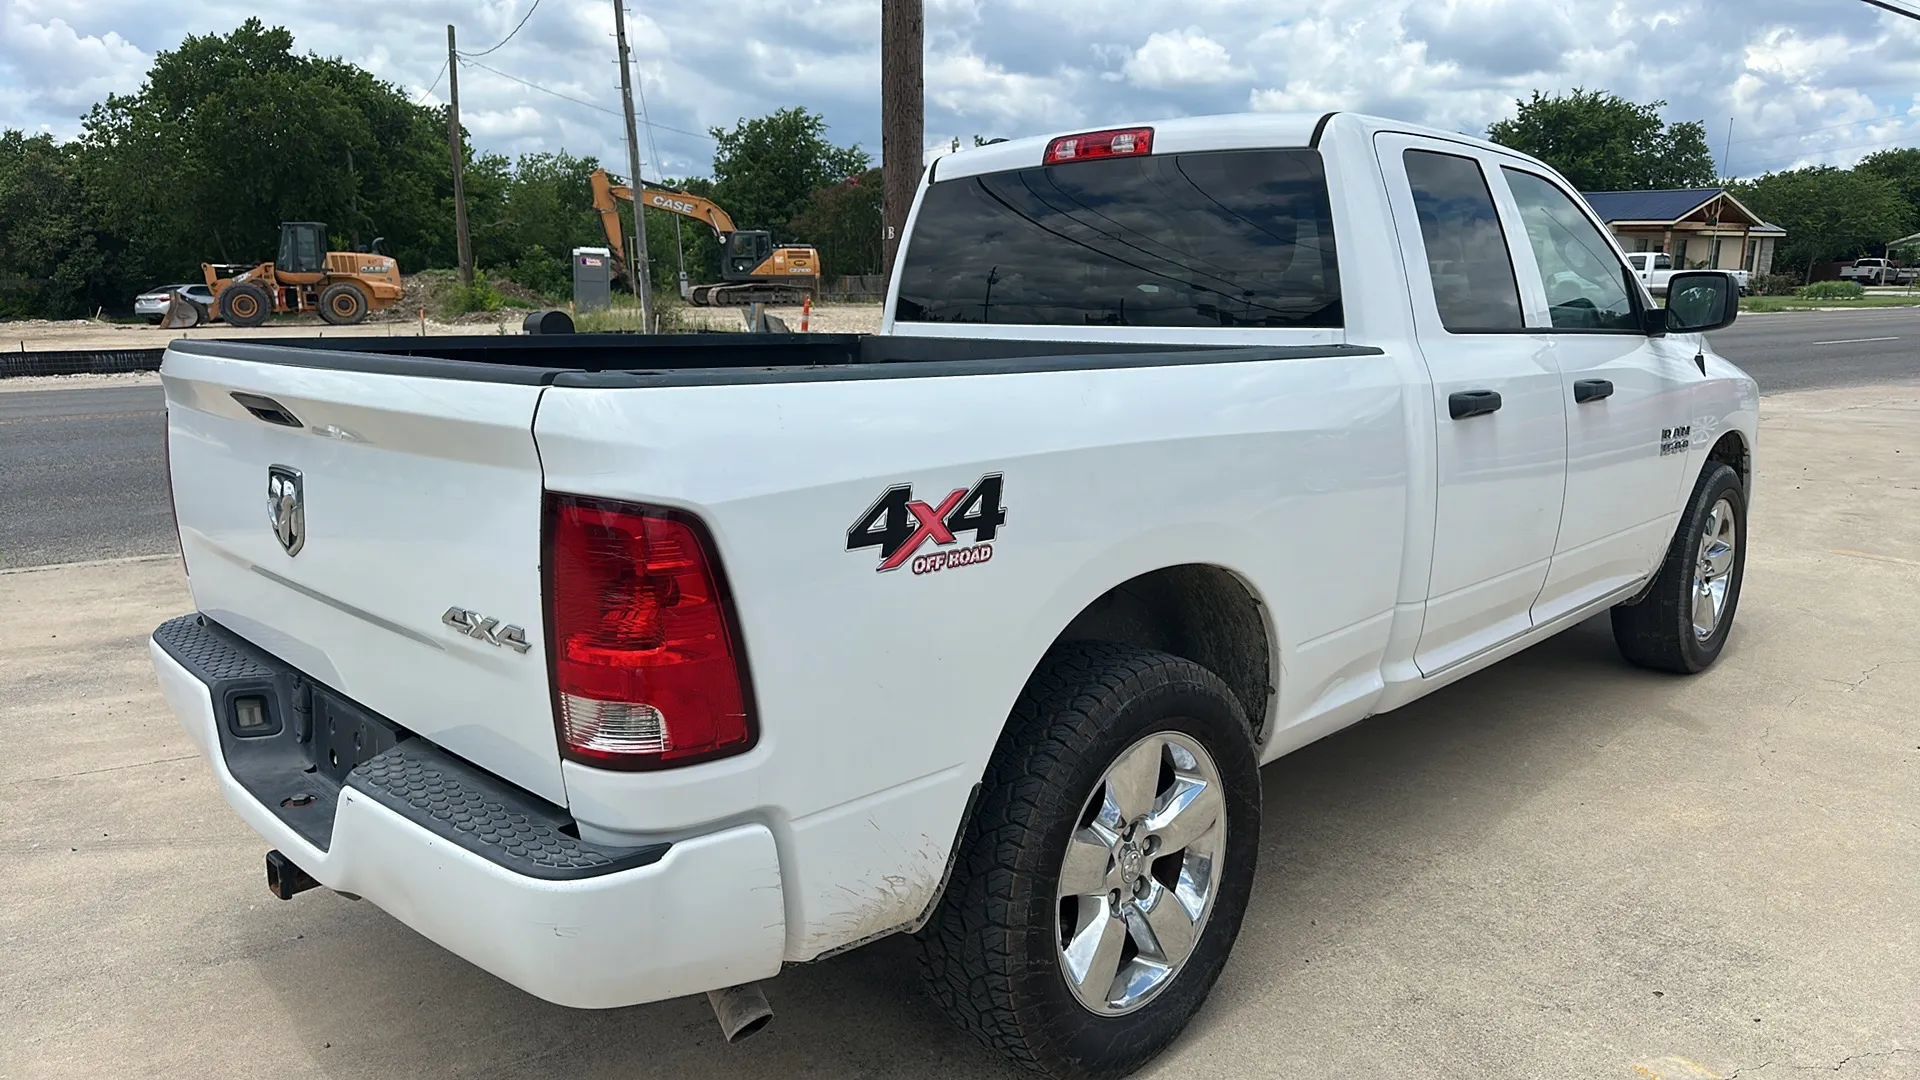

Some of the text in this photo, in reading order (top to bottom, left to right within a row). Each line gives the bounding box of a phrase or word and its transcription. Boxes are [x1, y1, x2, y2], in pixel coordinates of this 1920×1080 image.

[653, 196, 695, 214] CASE
[1661, 424, 1690, 441] RAM
[912, 544, 993, 576] OFF ROAD
